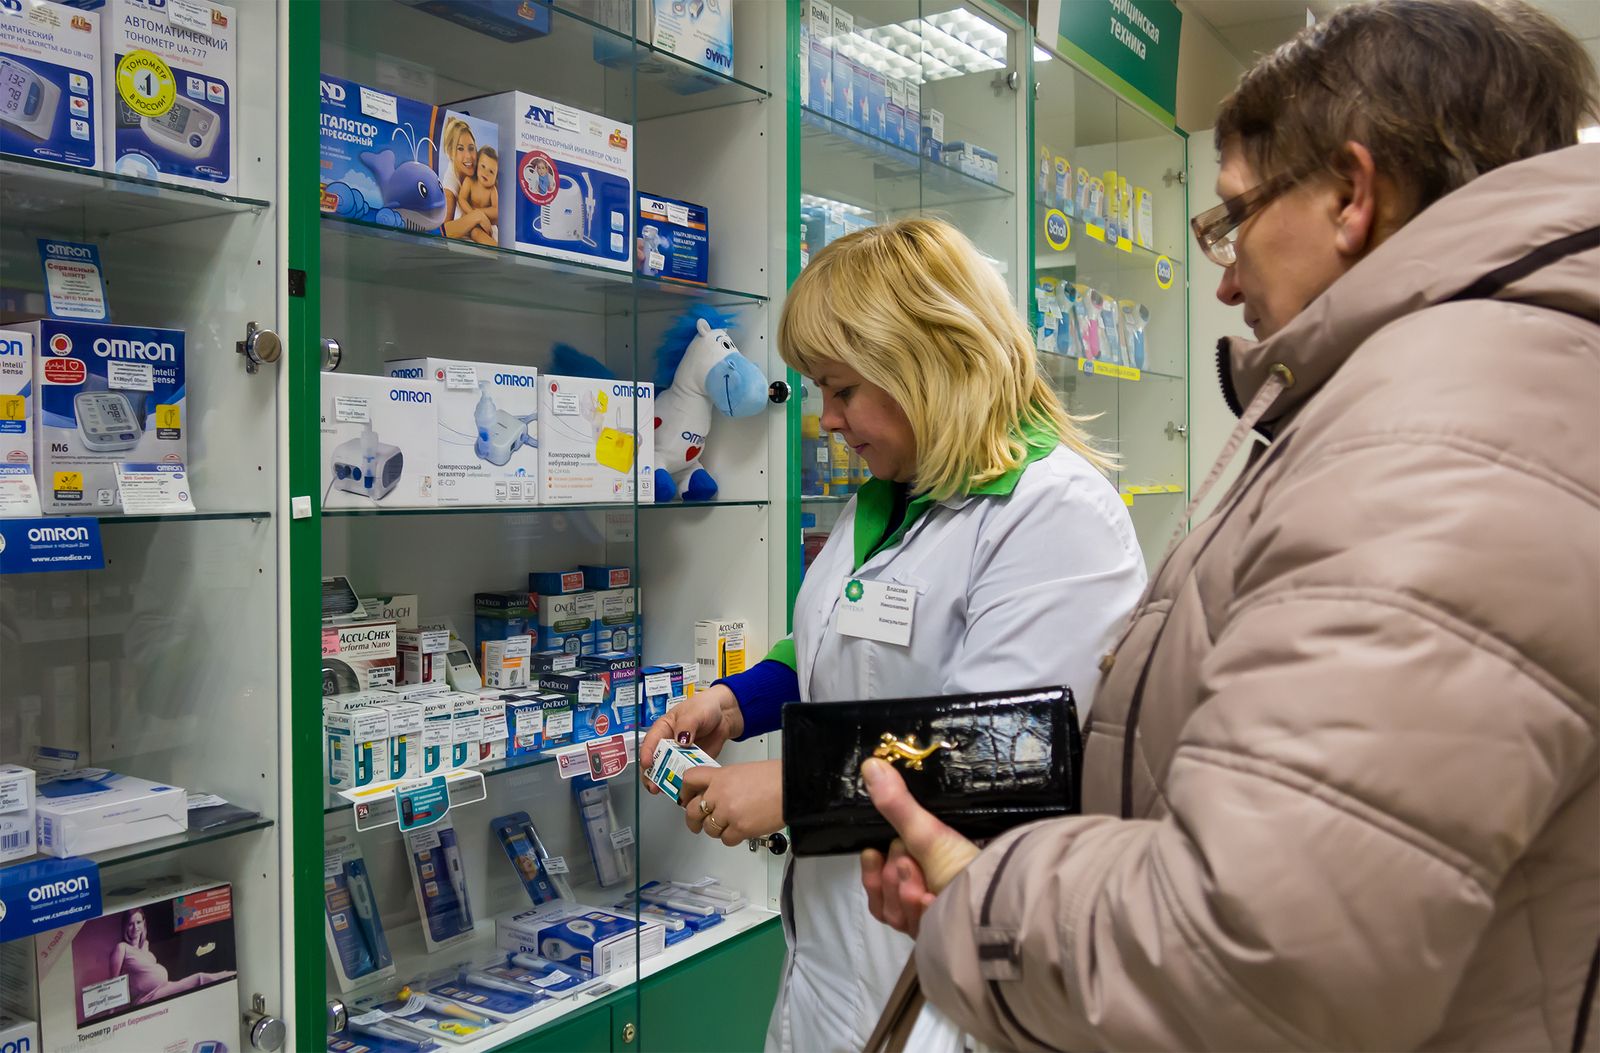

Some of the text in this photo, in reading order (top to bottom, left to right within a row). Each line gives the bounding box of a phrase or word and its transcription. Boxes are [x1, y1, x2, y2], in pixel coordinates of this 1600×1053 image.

[812, 7, 829, 24] ReNu
[124, 15, 228, 51] АВТОМАТИЧЕСКИЙ
[1110, 16, 1147, 61] техника
[125, 30, 175, 49] ТОНОМЕТР
[177, 45, 207, 59] UA-777
[126, 58, 167, 80] ТОНОМЕТР
[129, 93, 136, 101] В
[319, 127, 374, 147] ПРЕССОРНЫЙ
[614, 129, 621, 143] 5
[521, 132, 574, 151] КОМПРЕССОРНЫЙ
[574, 147, 605, 160] ИНГАЛЯТОР
[1048, 219, 1067, 238] Scholl
[46, 243, 92, 258] OMRON
[47, 262, 96, 274] Сервисный
[93, 338, 176, 361] OMRON
[2, 361, 24, 369] Intelli
[391, 367, 423, 379] OMRON
[494, 373, 534, 387] OMRON
[389, 389, 432, 403] OMRON
[51, 443, 69, 452] M6
[28, 527, 89, 542] OMRON
[886, 586, 908, 594] Власова
[383, 607, 410, 619] OUCH
[719, 622, 745, 631] ACCU-CHEK
[879, 617, 909, 626] Консультант
[339, 630, 391, 643] ACCU-CHEK
[372, 641, 391, 649] Nano
[540, 680, 569, 690] ONETOUCH
[543, 700, 569, 709] ONETOUCH
[359, 808, 368, 816] 24
[28, 876, 89, 902] OMRON
[78, 1007, 169, 1042] Тонометр для беременных
